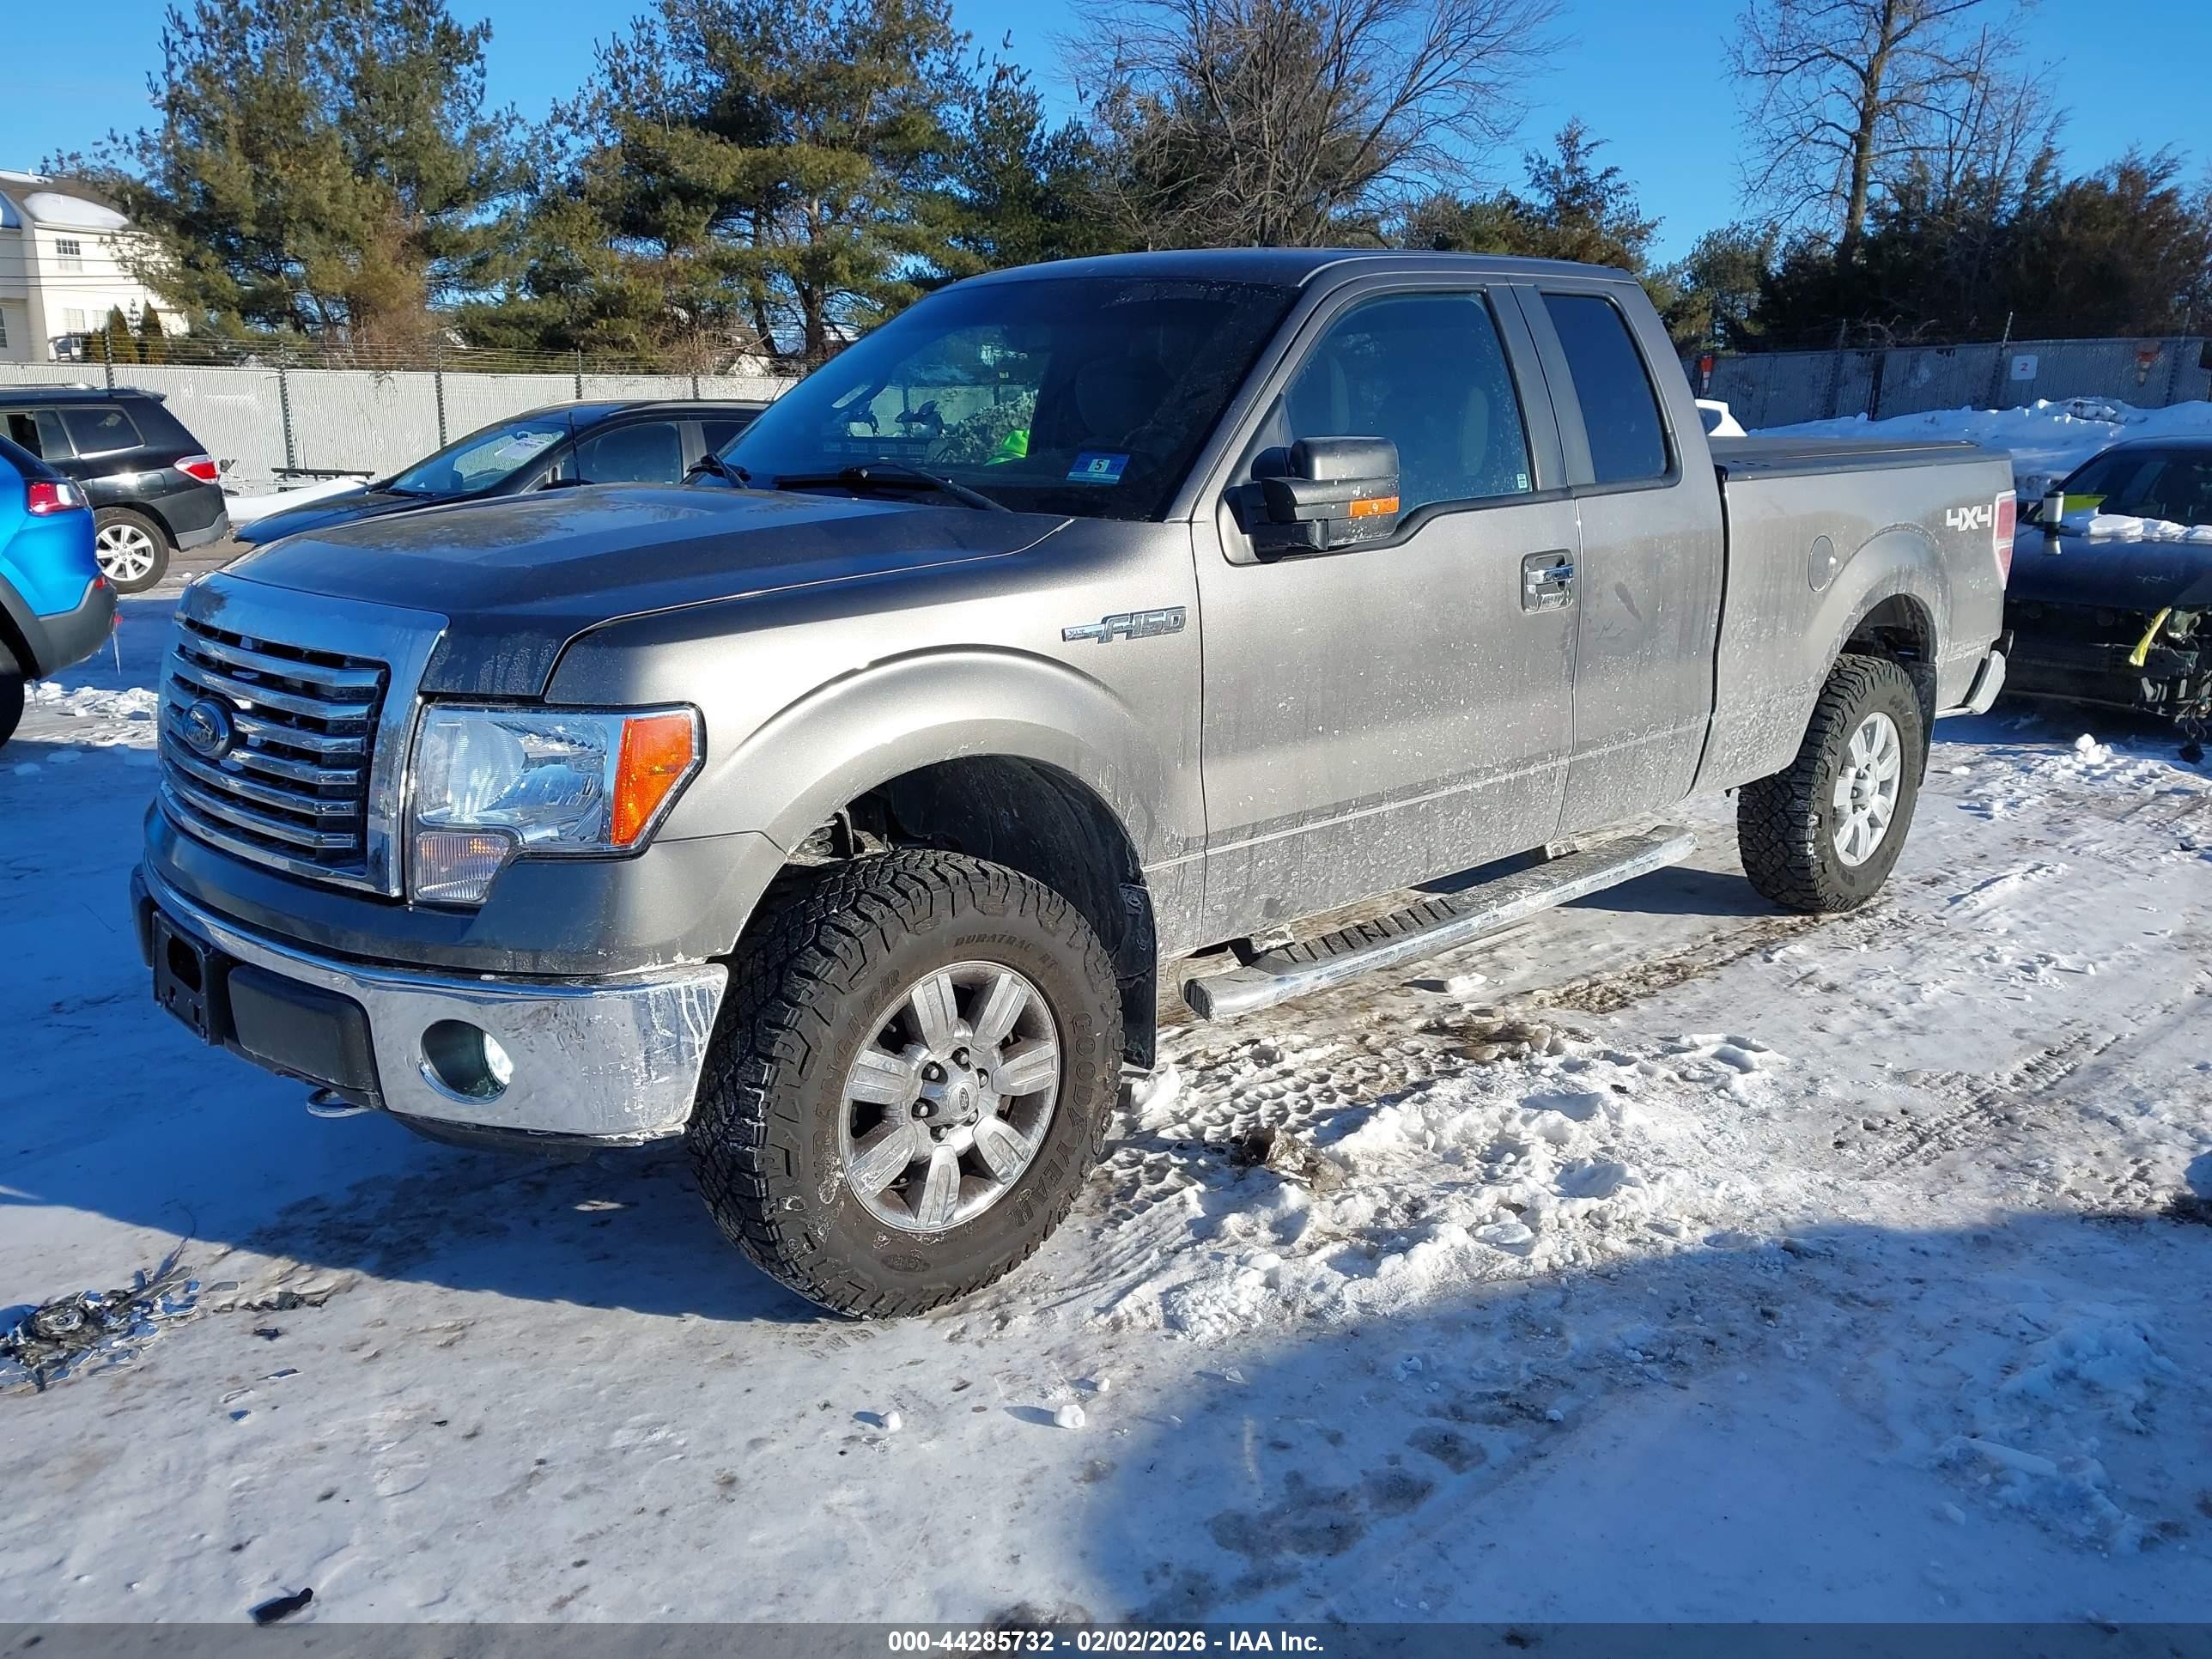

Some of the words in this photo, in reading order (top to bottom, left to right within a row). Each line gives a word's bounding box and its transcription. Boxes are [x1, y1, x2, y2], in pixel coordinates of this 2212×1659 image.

[2020, 362, 2029, 372] 2
[1094, 459, 1104, 471] 5
[1946, 504, 1992, 532] 4X4
[1007, 1012, 1097, 1228] GOODYEAR
